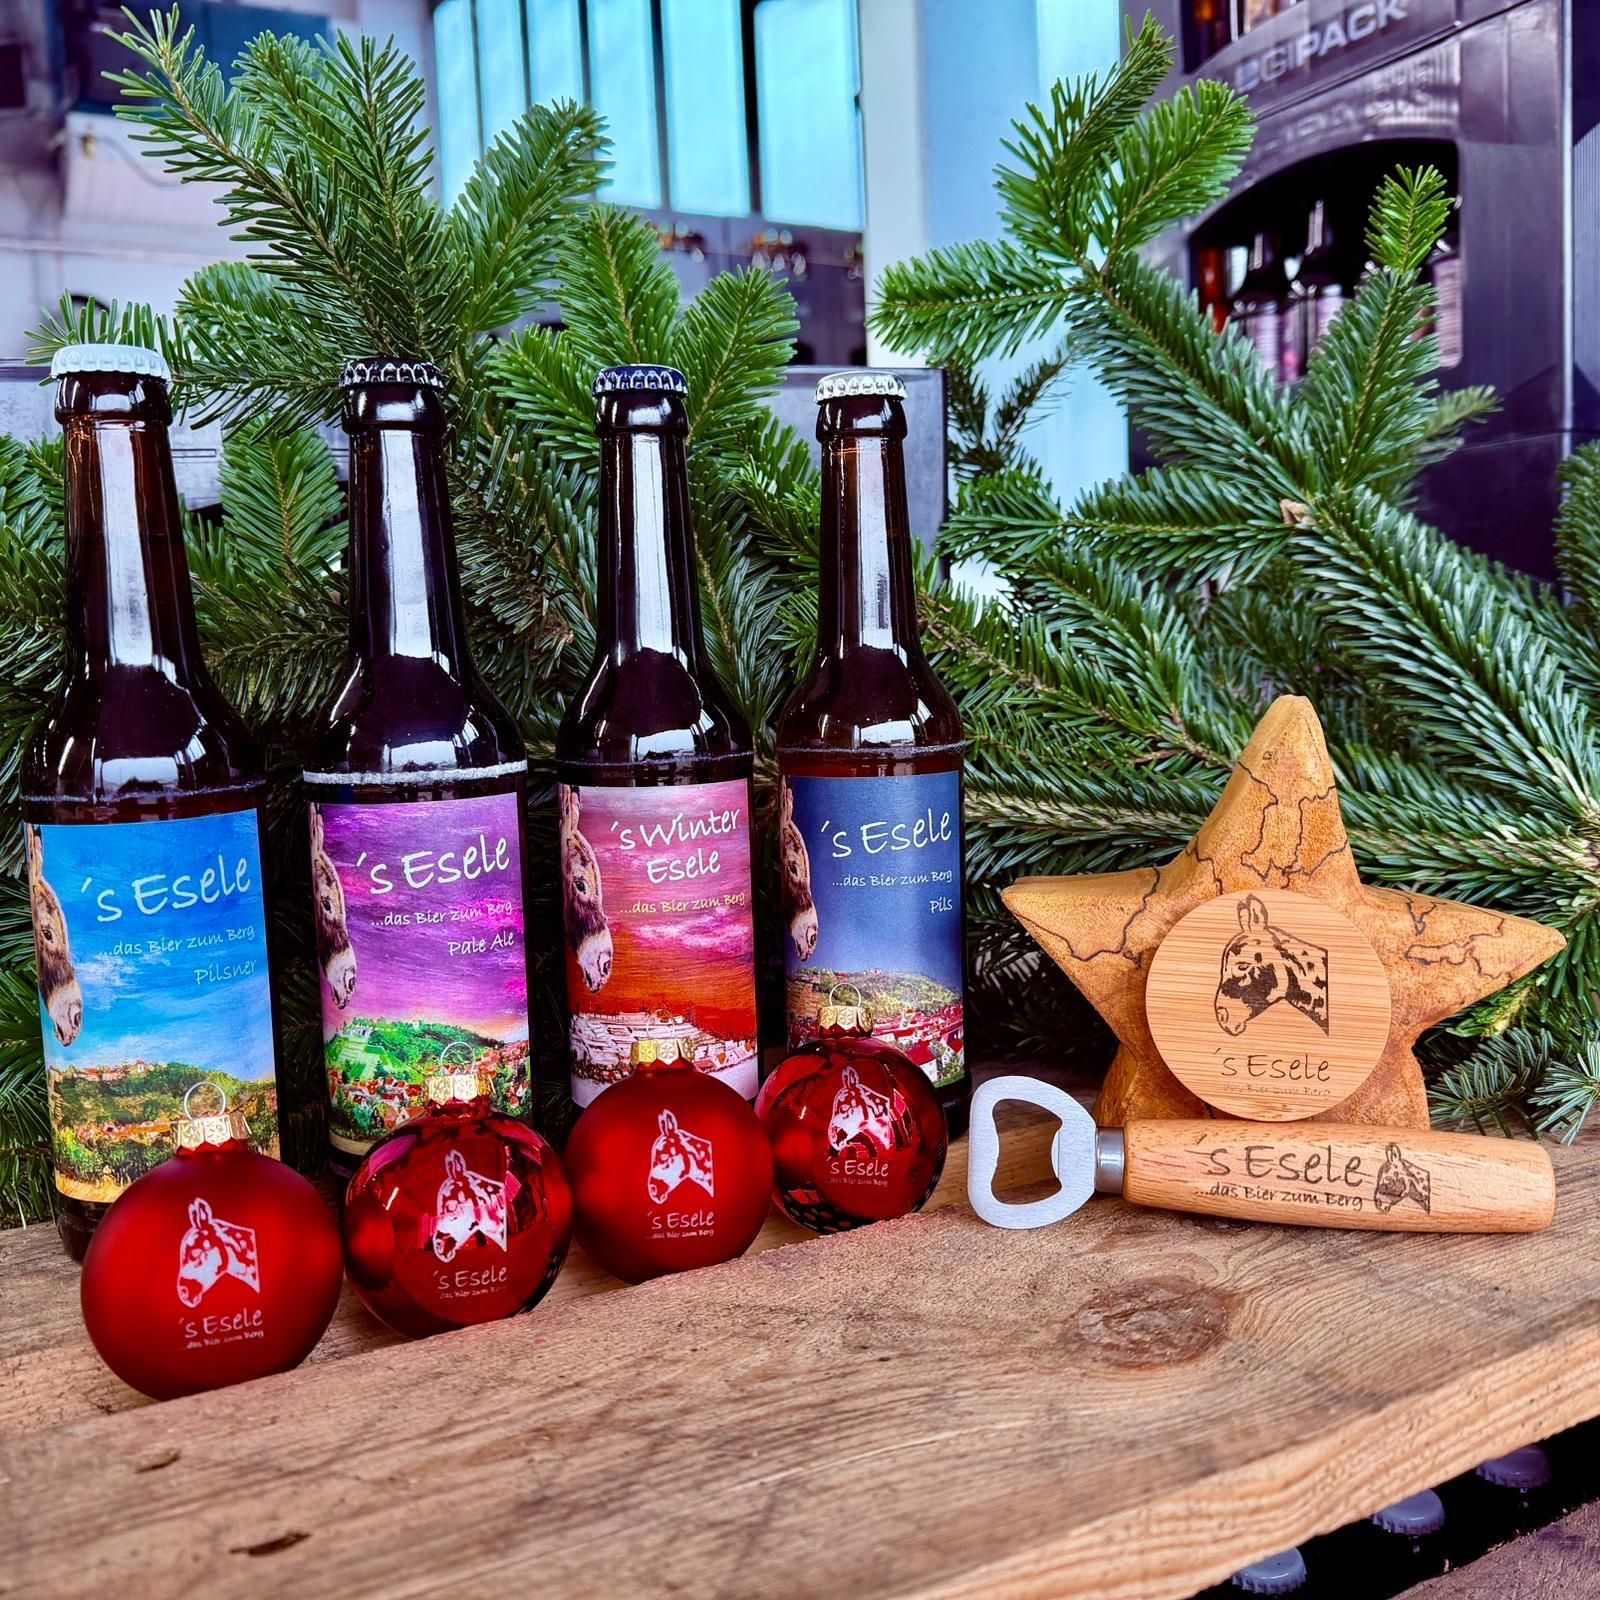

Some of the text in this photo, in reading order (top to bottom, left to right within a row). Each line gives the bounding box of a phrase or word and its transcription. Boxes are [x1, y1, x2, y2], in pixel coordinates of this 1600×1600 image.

[860, 808, 952, 854] Esele
[401, 833, 510, 889] Esele
[646, 848, 721, 884] Esele
[132, 854, 250, 915] Esele
[869, 873, 897, 887] Bier
[900, 874, 929, 885] zum
[931, 870, 952, 883] Berg
[414, 909, 446, 925] Bier
[450, 909, 483, 921] zum
[486, 902, 512, 916] Berg
[661, 899, 688, 912] Bier
[692, 898, 720, 911] zum
[723, 892, 745, 906] Berg
[929, 896, 953, 914] Pils
[147, 938, 183, 953] Bier
[187, 935, 223, 949] zum
[226, 925, 255, 941] Berg
[448, 930, 514, 956] Pale Ale
[194, 959, 257, 985] Pilsner
[1246, 1053, 1331, 1082] Esele
[844, 1159, 889, 1177] Esele
[1244, 1144, 1363, 1187] Esele
[1244, 1185, 1276, 1200] Bier
[1280, 1190, 1320, 1204] zum
[1324, 1191, 1363, 1212] Berg
[667, 1208, 715, 1229] Esele
[455, 1264, 508, 1287] Esele
[202, 1307, 263, 1335] Esele
